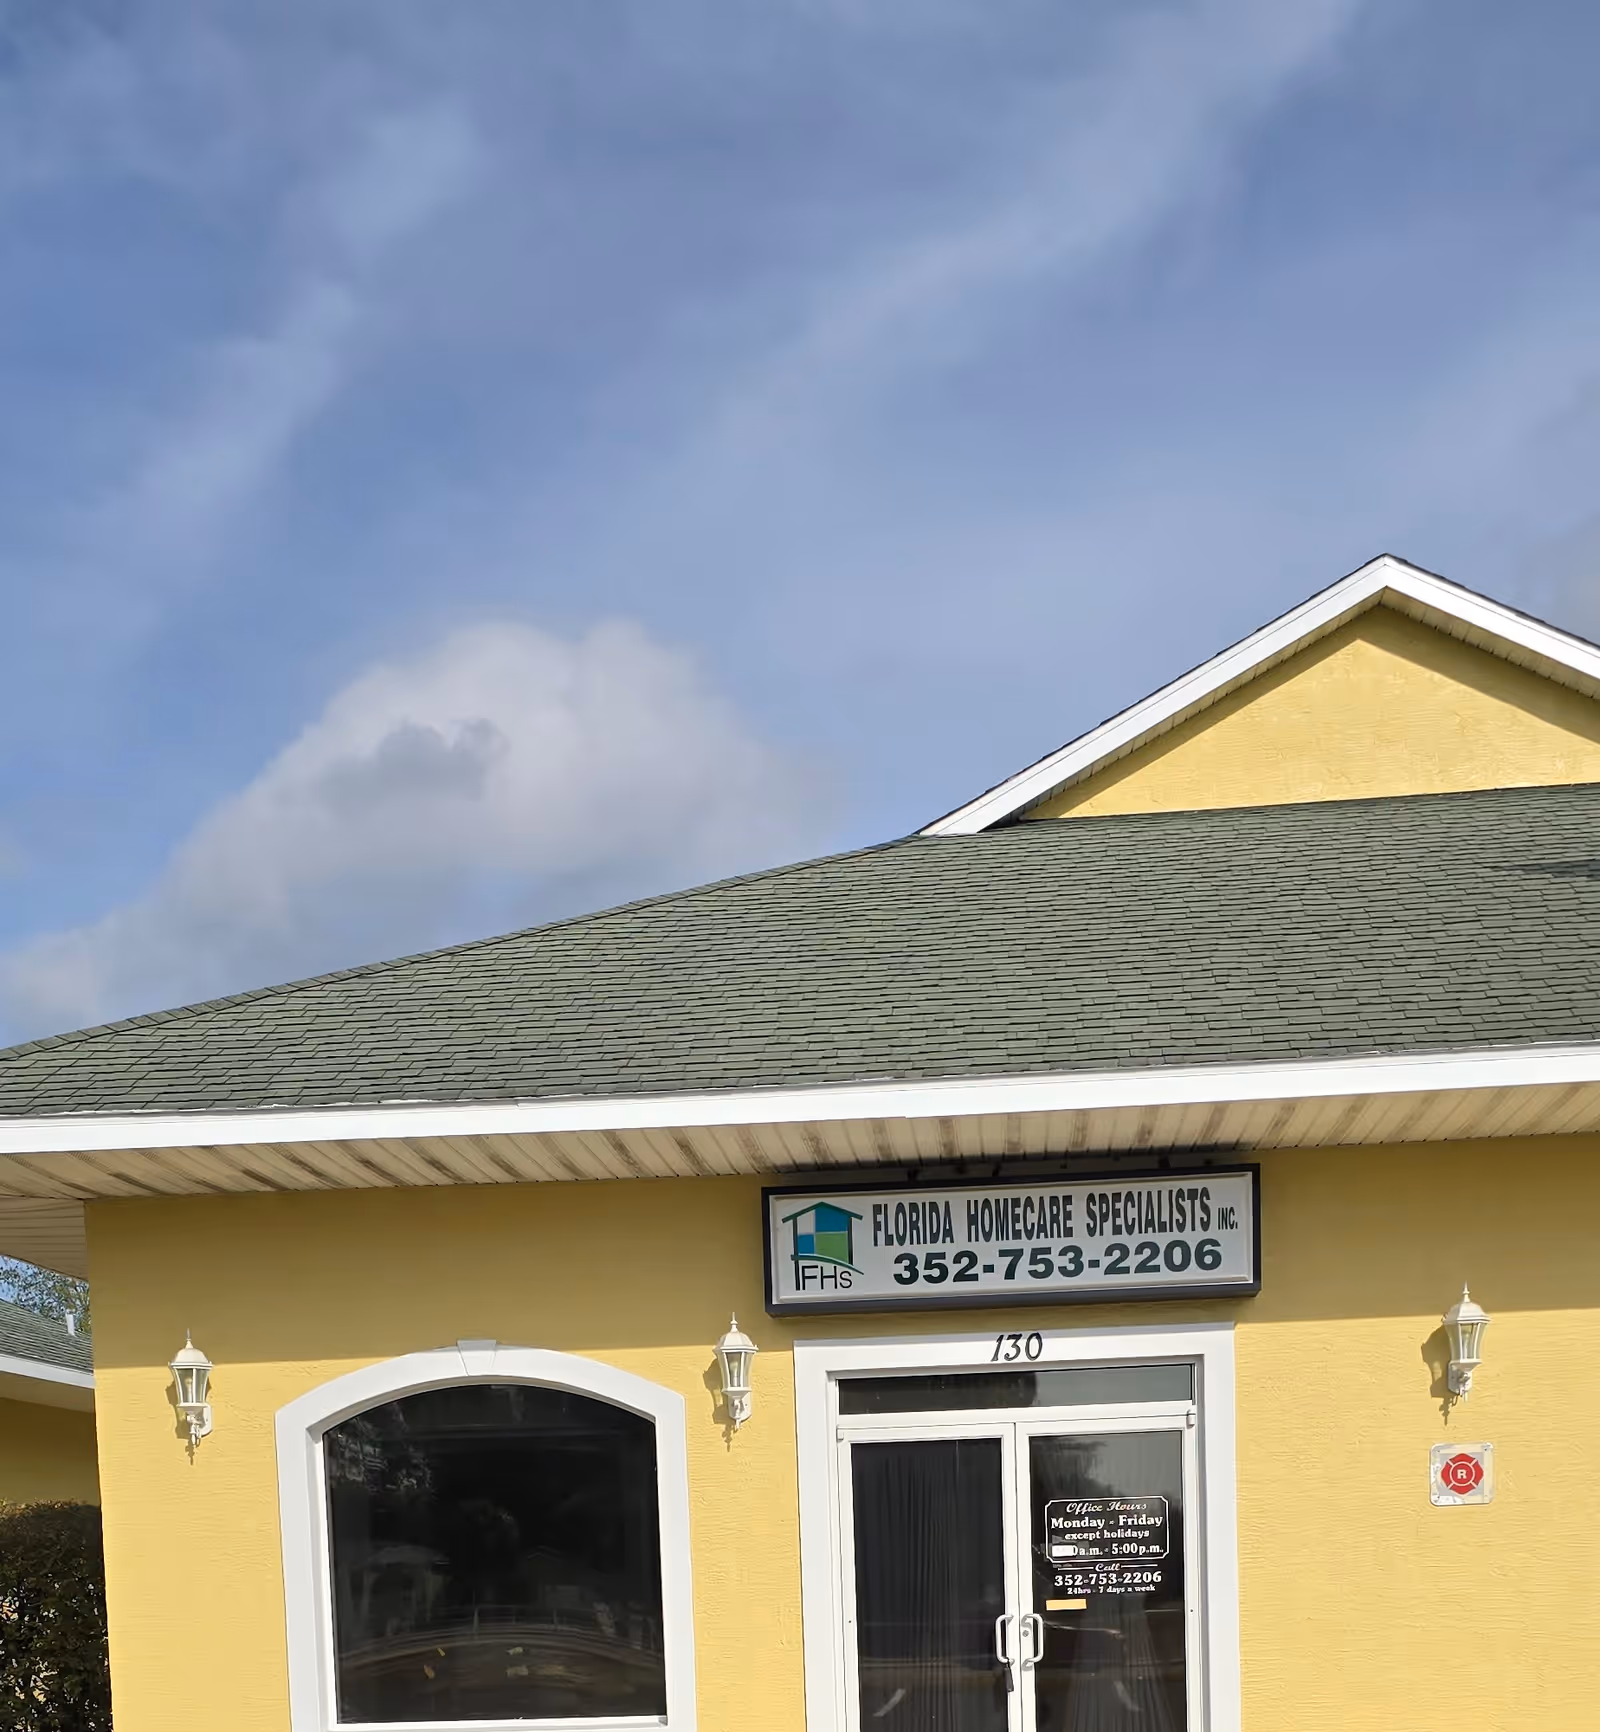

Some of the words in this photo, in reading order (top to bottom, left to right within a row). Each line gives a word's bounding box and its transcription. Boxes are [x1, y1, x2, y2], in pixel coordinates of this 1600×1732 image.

[873, 1201, 955, 1246] FLORIDA
[967, 1194, 1073, 1243] HOMECARE
[1086, 1186, 1211, 1237] SPECIALISTS
[1217, 1206, 1238, 1231] INC.
[893, 1238, 1222, 1285] 352-753-2206
[991, 1332, 1043, 1362] 130
[1457, 1469, 1467, 1479] R
[1066, 1503, 1103, 1515] Office
[1106, 1502, 1146, 1511] Hours
[1051, 1517, 1105, 1529] Monday
[1118, 1515, 1162, 1526] Friday
[1065, 1532, 1100, 1540] except
[1104, 1529, 1149, 1539] holidays
[1095, 1564, 1120, 1572] Call
[1054, 1571, 1162, 1586] 352-753-2206
[1107, 1586, 1125, 1594] days
